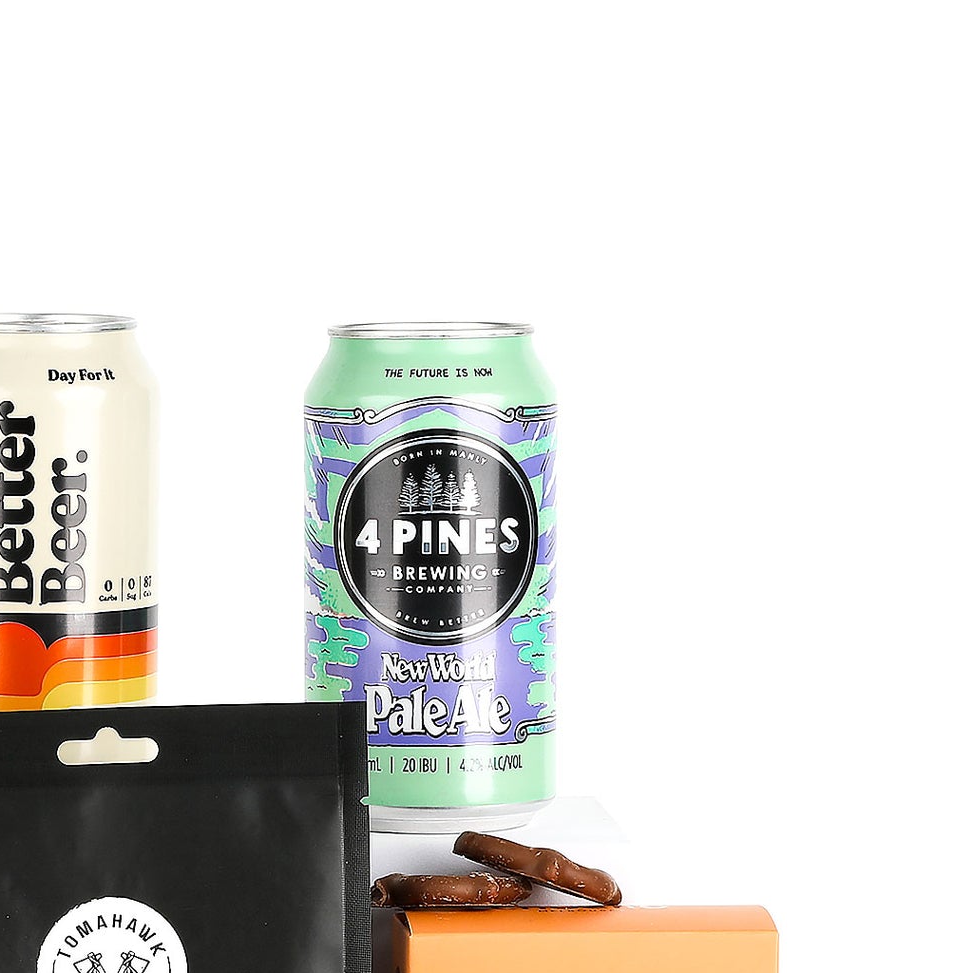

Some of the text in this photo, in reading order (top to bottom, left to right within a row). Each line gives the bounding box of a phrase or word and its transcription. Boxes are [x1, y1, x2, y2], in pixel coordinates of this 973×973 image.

[48, 367, 115, 384] Day For It
[385, 367, 493, 378] THE FUTURE IS NOW
[393, 450, 423, 466] BORN
[449, 450, 488, 466] MANLY
[38, 449, 88, 606] Beer.
[355, 517, 520, 555] 4 PINES
[392, 564, 487, 581] BREWING
[104, 579, 112, 592] 0
[128, 578, 135, 590] 0
[405, 585, 474, 594] COMPANY
[380, 650, 496, 682] New World
[363, 683, 512, 738] Pale Ale
[402, 757, 417, 772] 20
[419, 757, 437, 773] IBU
[56, 913, 167, 958] TOMAHAWK
